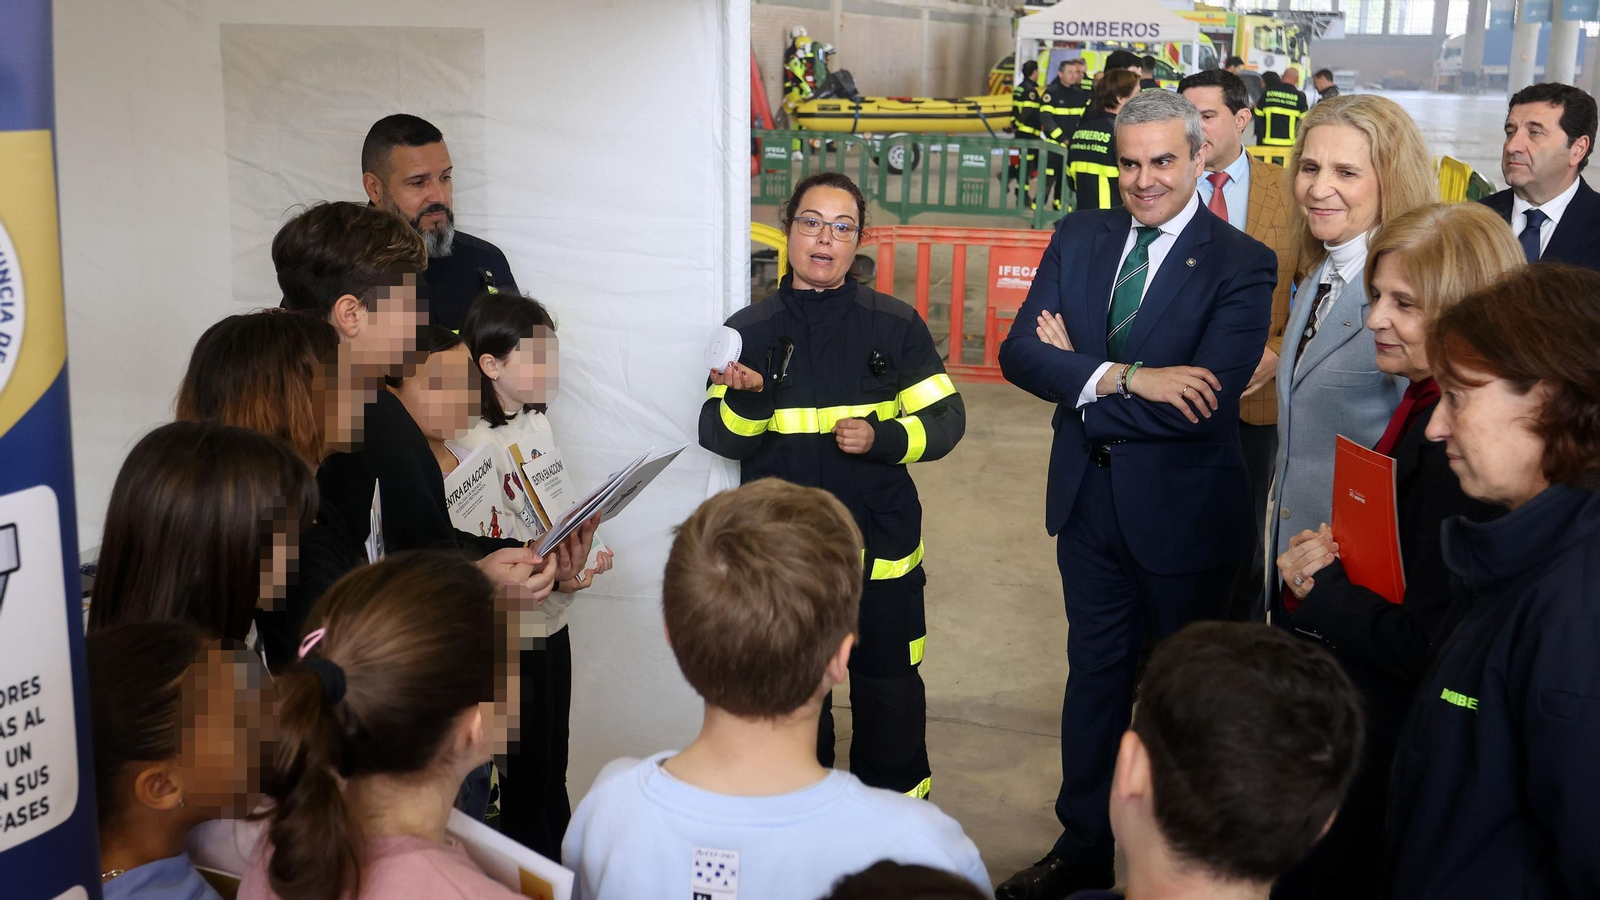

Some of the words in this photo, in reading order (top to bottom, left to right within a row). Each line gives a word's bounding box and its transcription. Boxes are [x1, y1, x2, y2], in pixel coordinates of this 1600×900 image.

[1053, 21, 1160, 37] BOMBEROS
[24, 706, 45, 731] AL
[6, 742, 32, 767] UN
[15, 765, 49, 795] SUS
[0, 795, 49, 833] ASES
